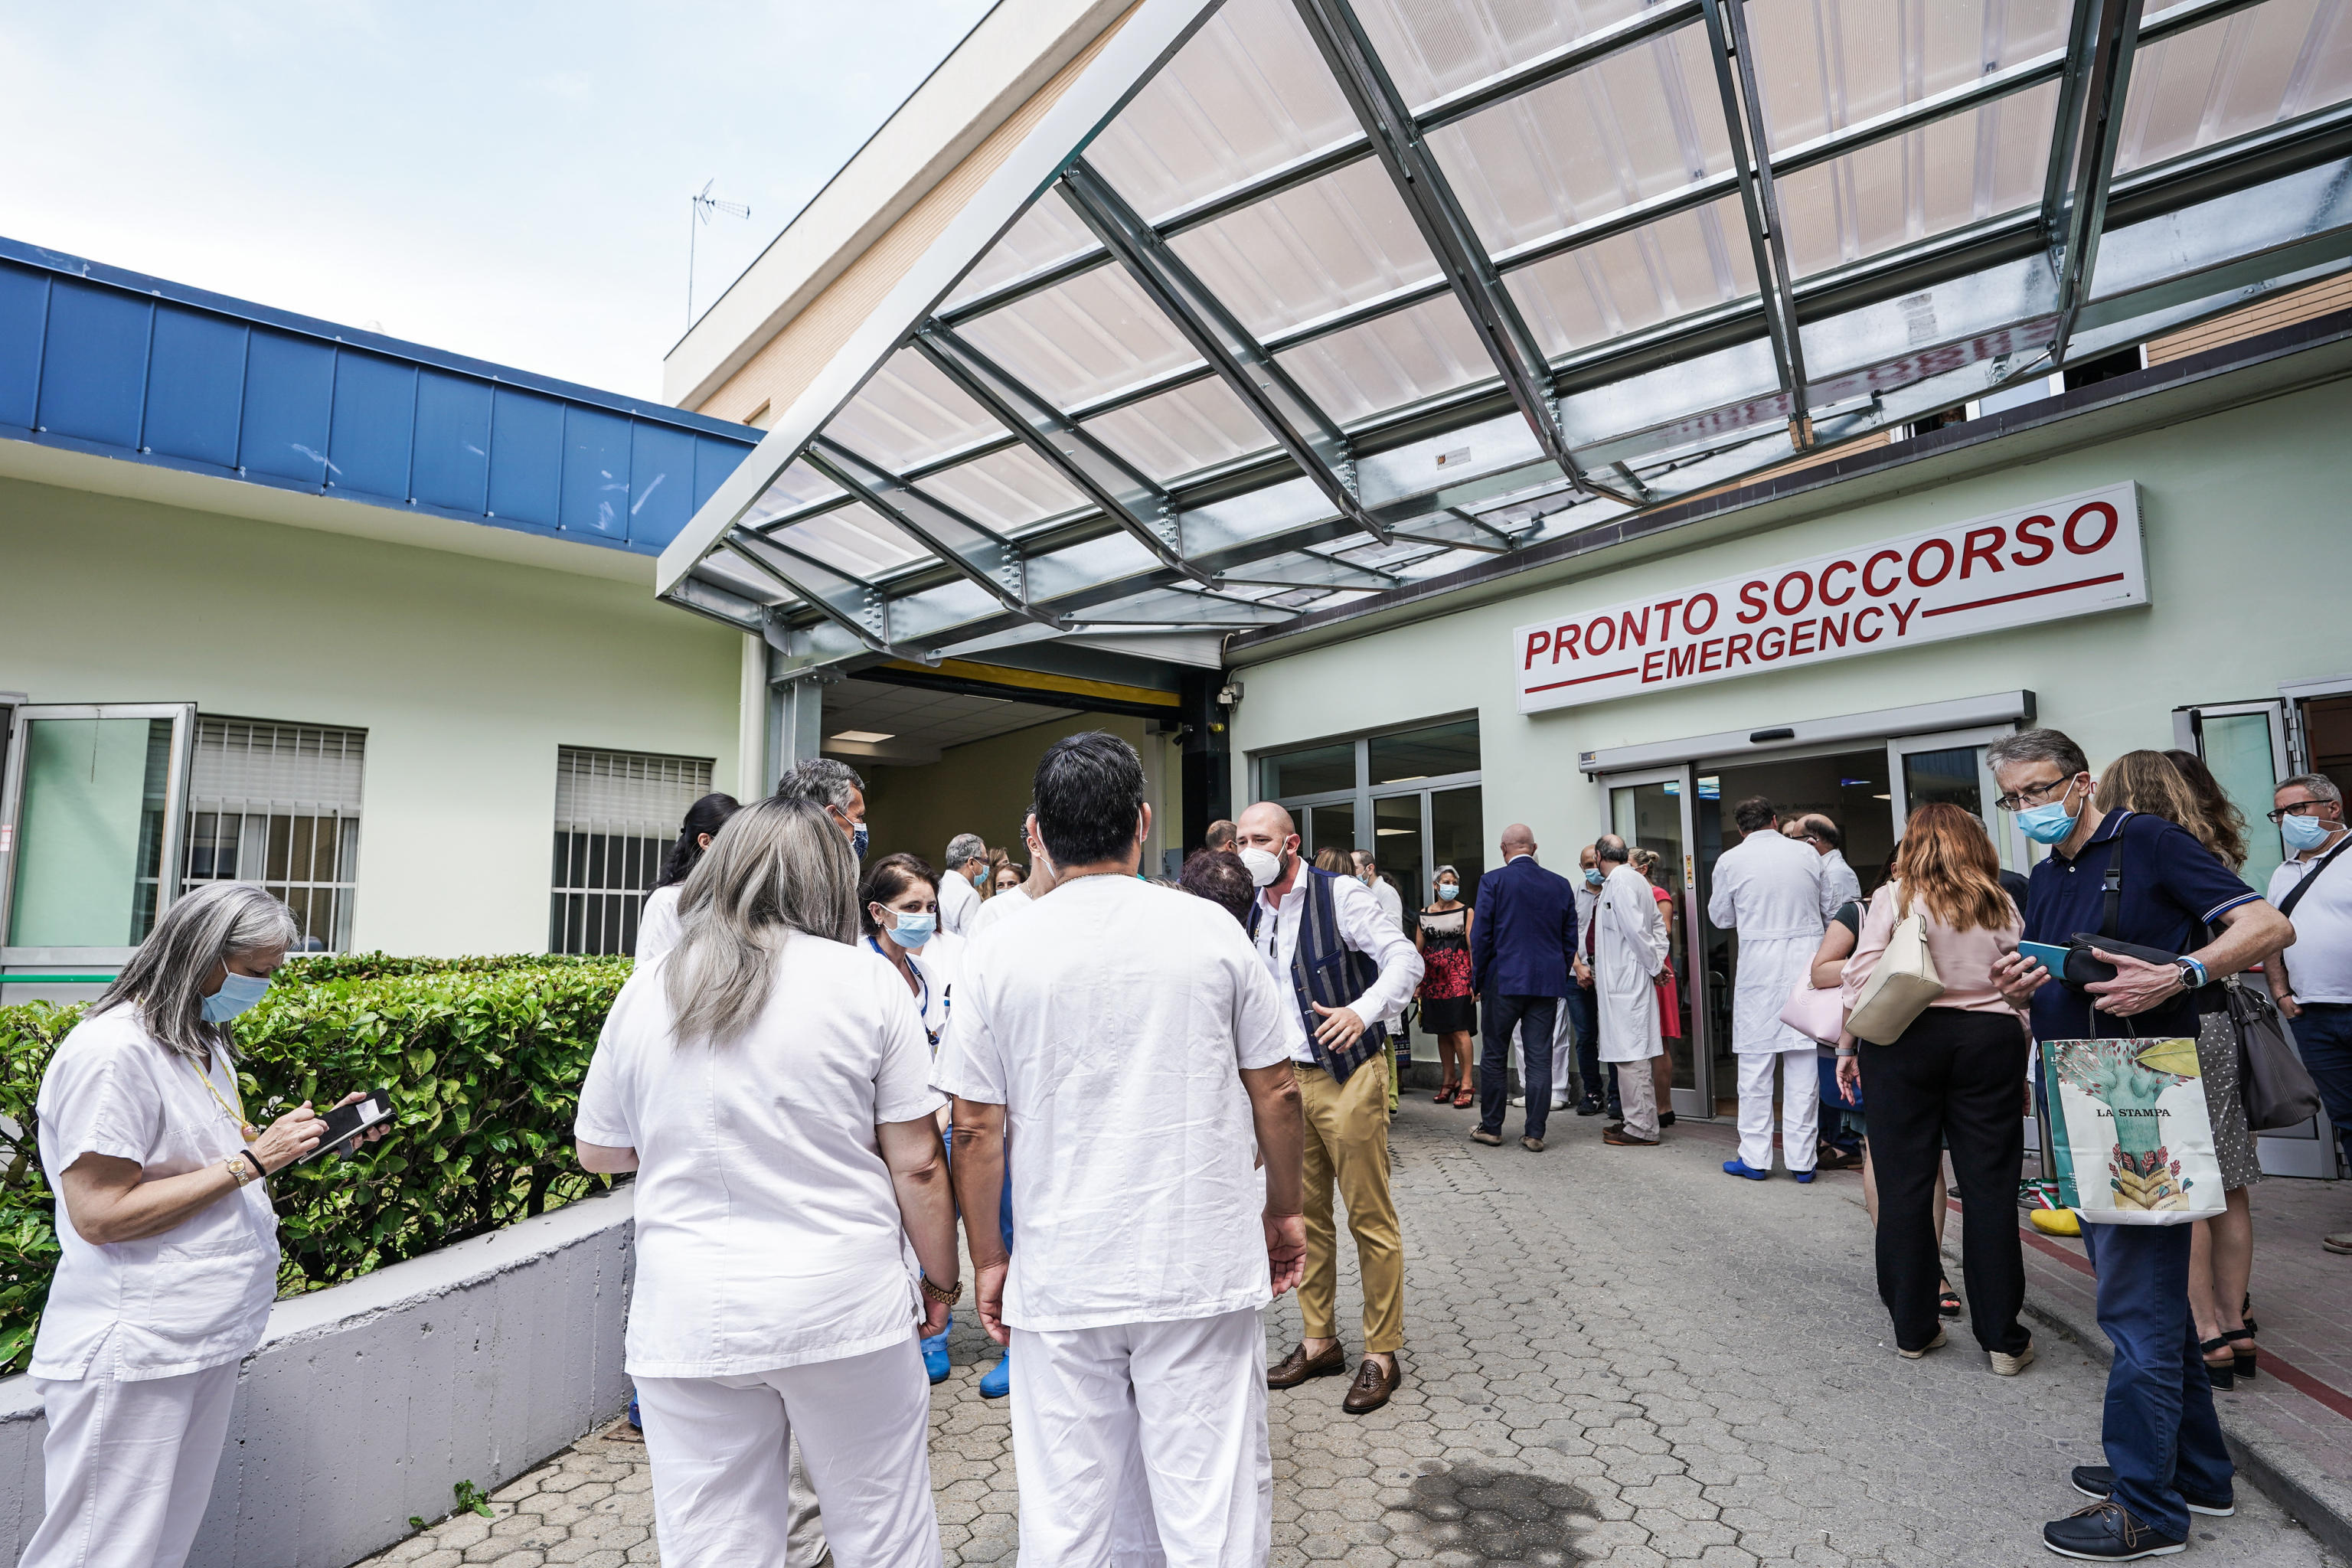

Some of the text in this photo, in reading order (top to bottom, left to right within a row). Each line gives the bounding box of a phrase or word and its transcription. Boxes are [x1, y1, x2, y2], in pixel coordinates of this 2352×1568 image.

[1524, 501, 2118, 670] PRONTO SOCCORSO
[1642, 596, 1920, 684] EMERGENCY
[2096, 1109, 2171, 1117] LA STAMPA
